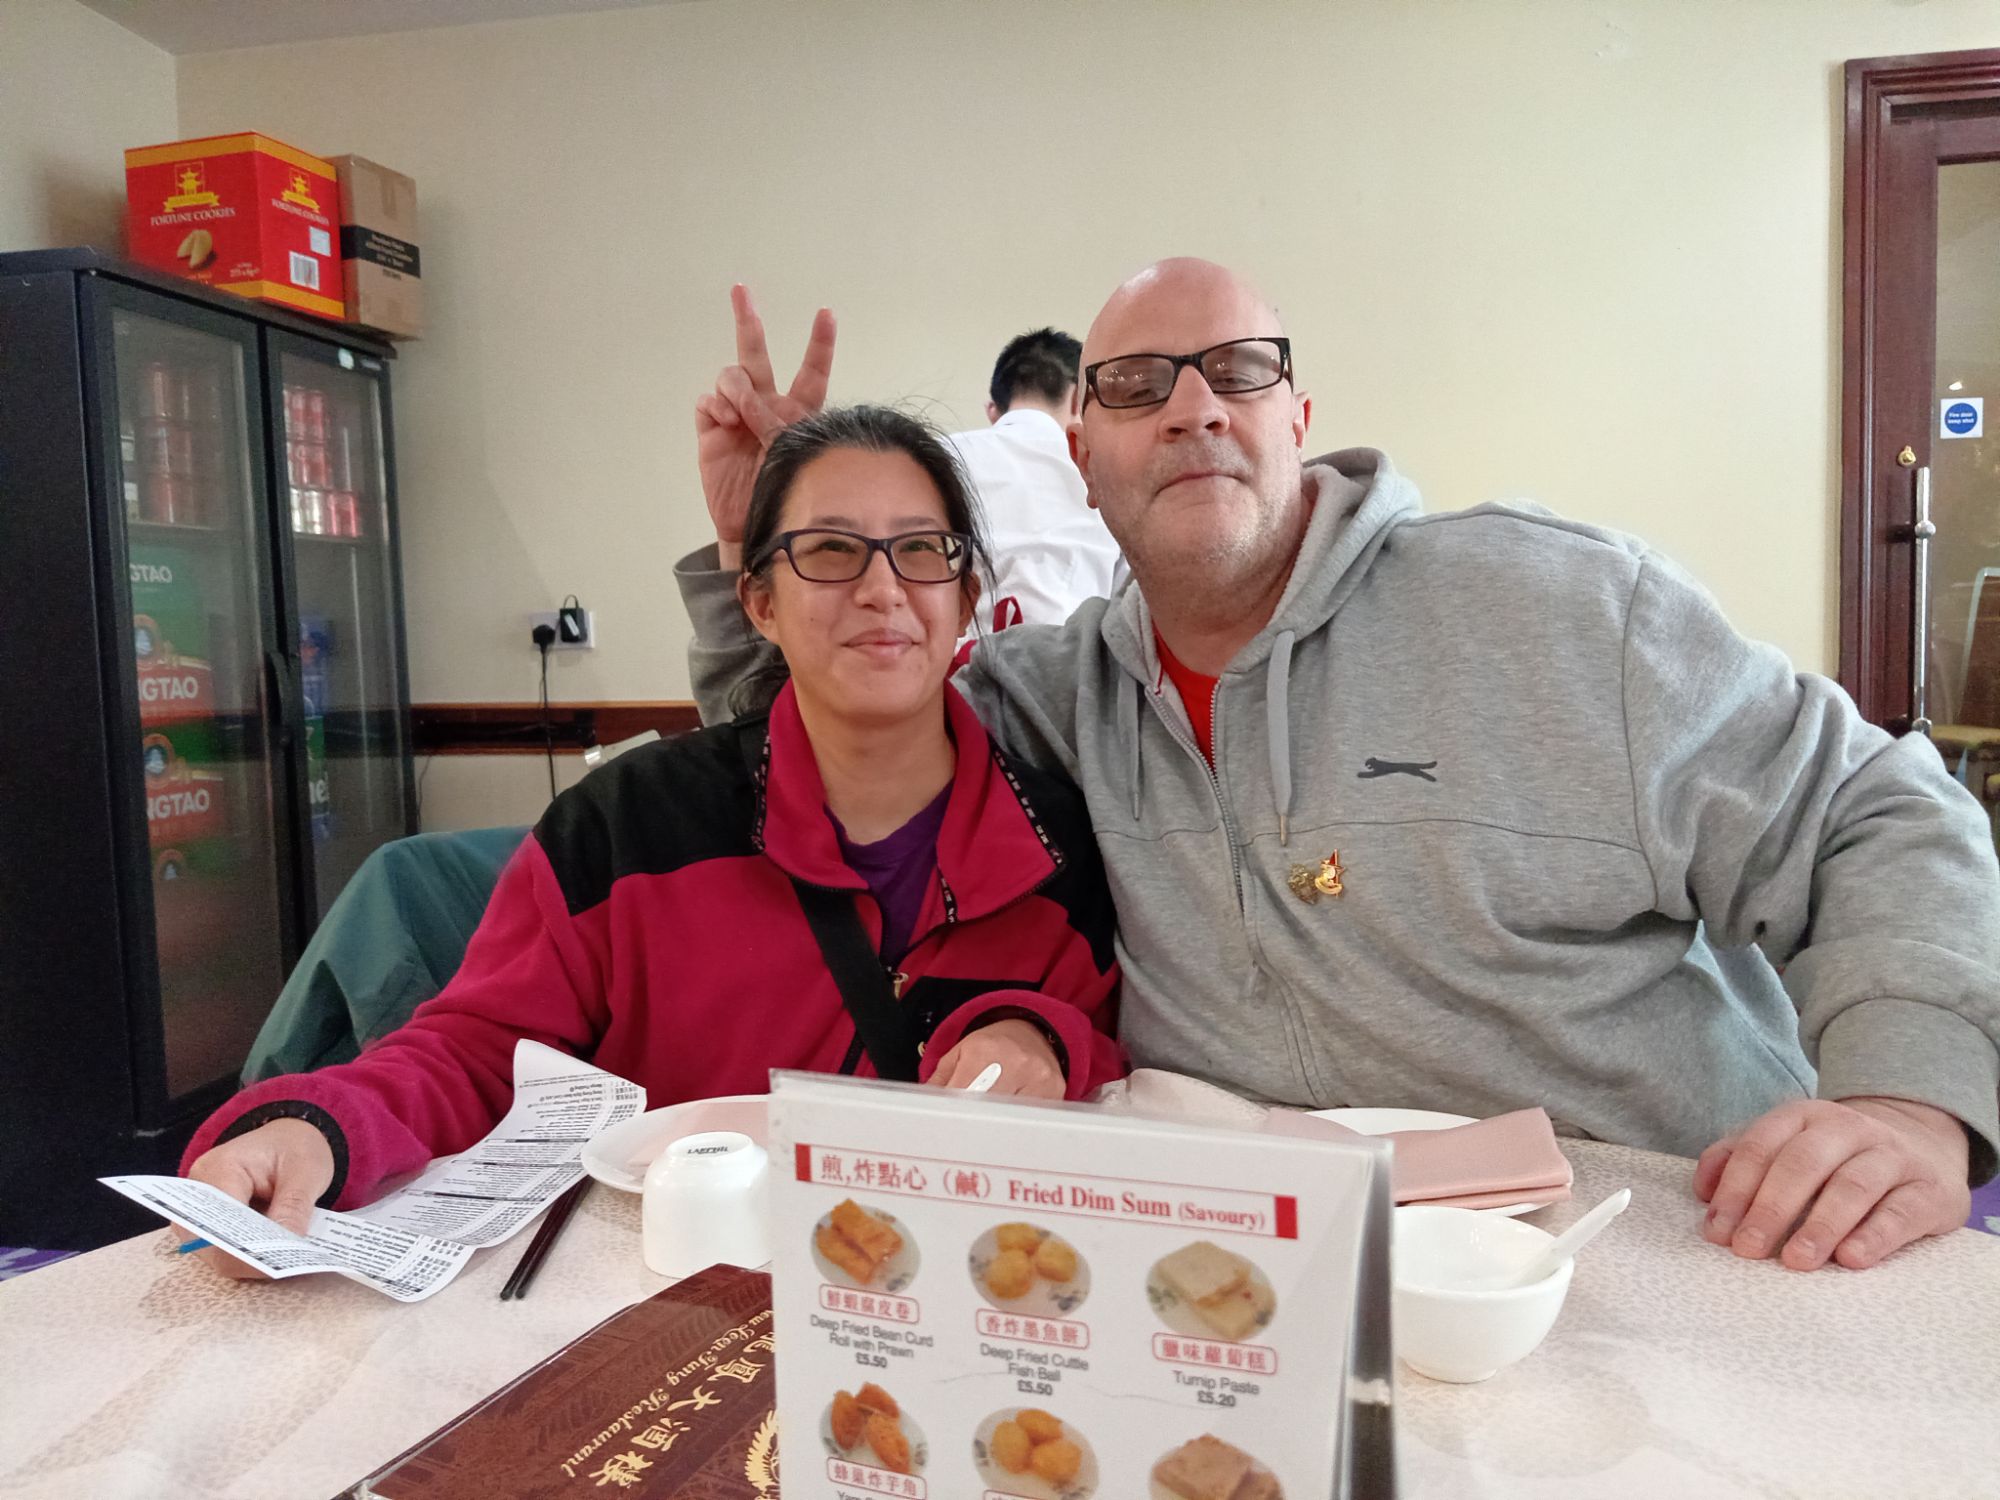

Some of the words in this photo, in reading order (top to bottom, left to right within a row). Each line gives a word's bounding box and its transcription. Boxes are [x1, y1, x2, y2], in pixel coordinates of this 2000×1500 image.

[151, 212, 194, 226] FORTUNE
[194, 207, 236, 221] COOKIES
[138, 676, 199, 701] GTAO
[1008, 1180, 1064, 1206] Fried
[1071, 1186, 1115, 1211] Dim
[1121, 1191, 1172, 1217] Sum
[1178, 1202, 1266, 1230] (Savoury)
[810, 1314, 839, 1331] Deep
[842, 1320, 870, 1336] Fried
[872, 1325, 902, 1342] Bean
[905, 1331, 934, 1347] Curd
[829, 1332, 850, 1346] Roll
[854, 1340, 875, 1351] with
[878, 1342, 914, 1358] Prawn
[980, 1343, 1014, 1361] Deep
[1017, 1348, 1048, 1365] Fried
[1051, 1353, 1089, 1370] Cuttle
[856, 1352, 888, 1368] £5.50
[1008, 1363, 1035, 1377] Fish
[1038, 1367, 1061, 1382] Ball
[1017, 1380, 1053, 1395] £5.50
[1172, 1370, 1216, 1389] Turnip
[1220, 1377, 1260, 1395] Paste
[1197, 1390, 1237, 1407] £5.20
[561, 1388, 670, 1478] Restaurant
